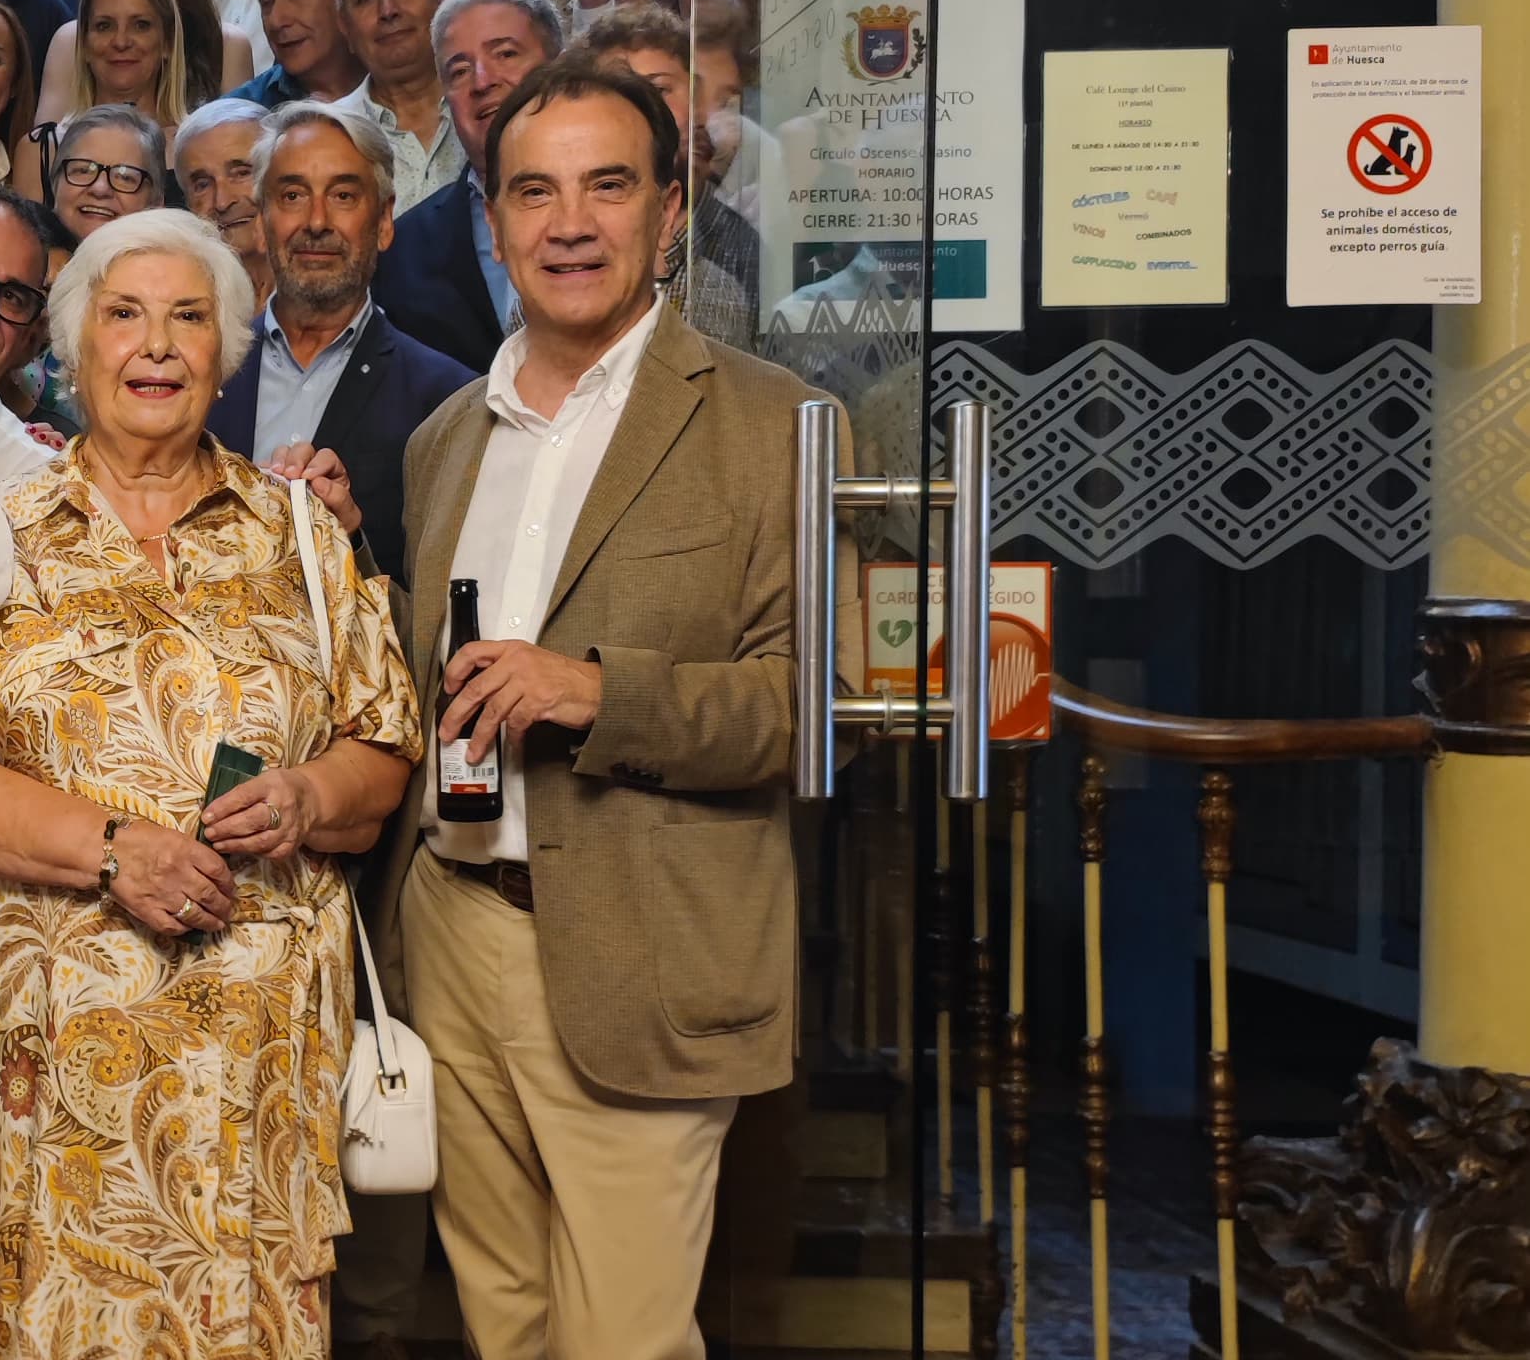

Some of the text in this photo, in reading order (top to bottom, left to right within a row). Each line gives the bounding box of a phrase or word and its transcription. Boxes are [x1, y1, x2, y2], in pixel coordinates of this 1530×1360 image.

[1332, 43, 1403, 56] Ayuntamiento
[1332, 55, 1385, 65] de Huesca
[828, 111, 852, 124] DE
[857, 167, 916, 179] HORARIO
[787, 189, 877, 203] APERTURA:
[937, 186, 995, 201] HORAS
[1320, 207, 1335, 219] Se
[1387, 206, 1398, 218] el
[1400, 207, 1440, 218] acceso
[1443, 206, 1458, 217] de
[802, 214, 862, 229] CIERRE:
[866, 213, 912, 228] 21:30
[1135, 228, 1193, 241] COMBINADOS
[1326, 223, 1453, 236] animales domésticos,
[1330, 242, 1376, 254] excepto
[1380, 241, 1418, 254] perros
